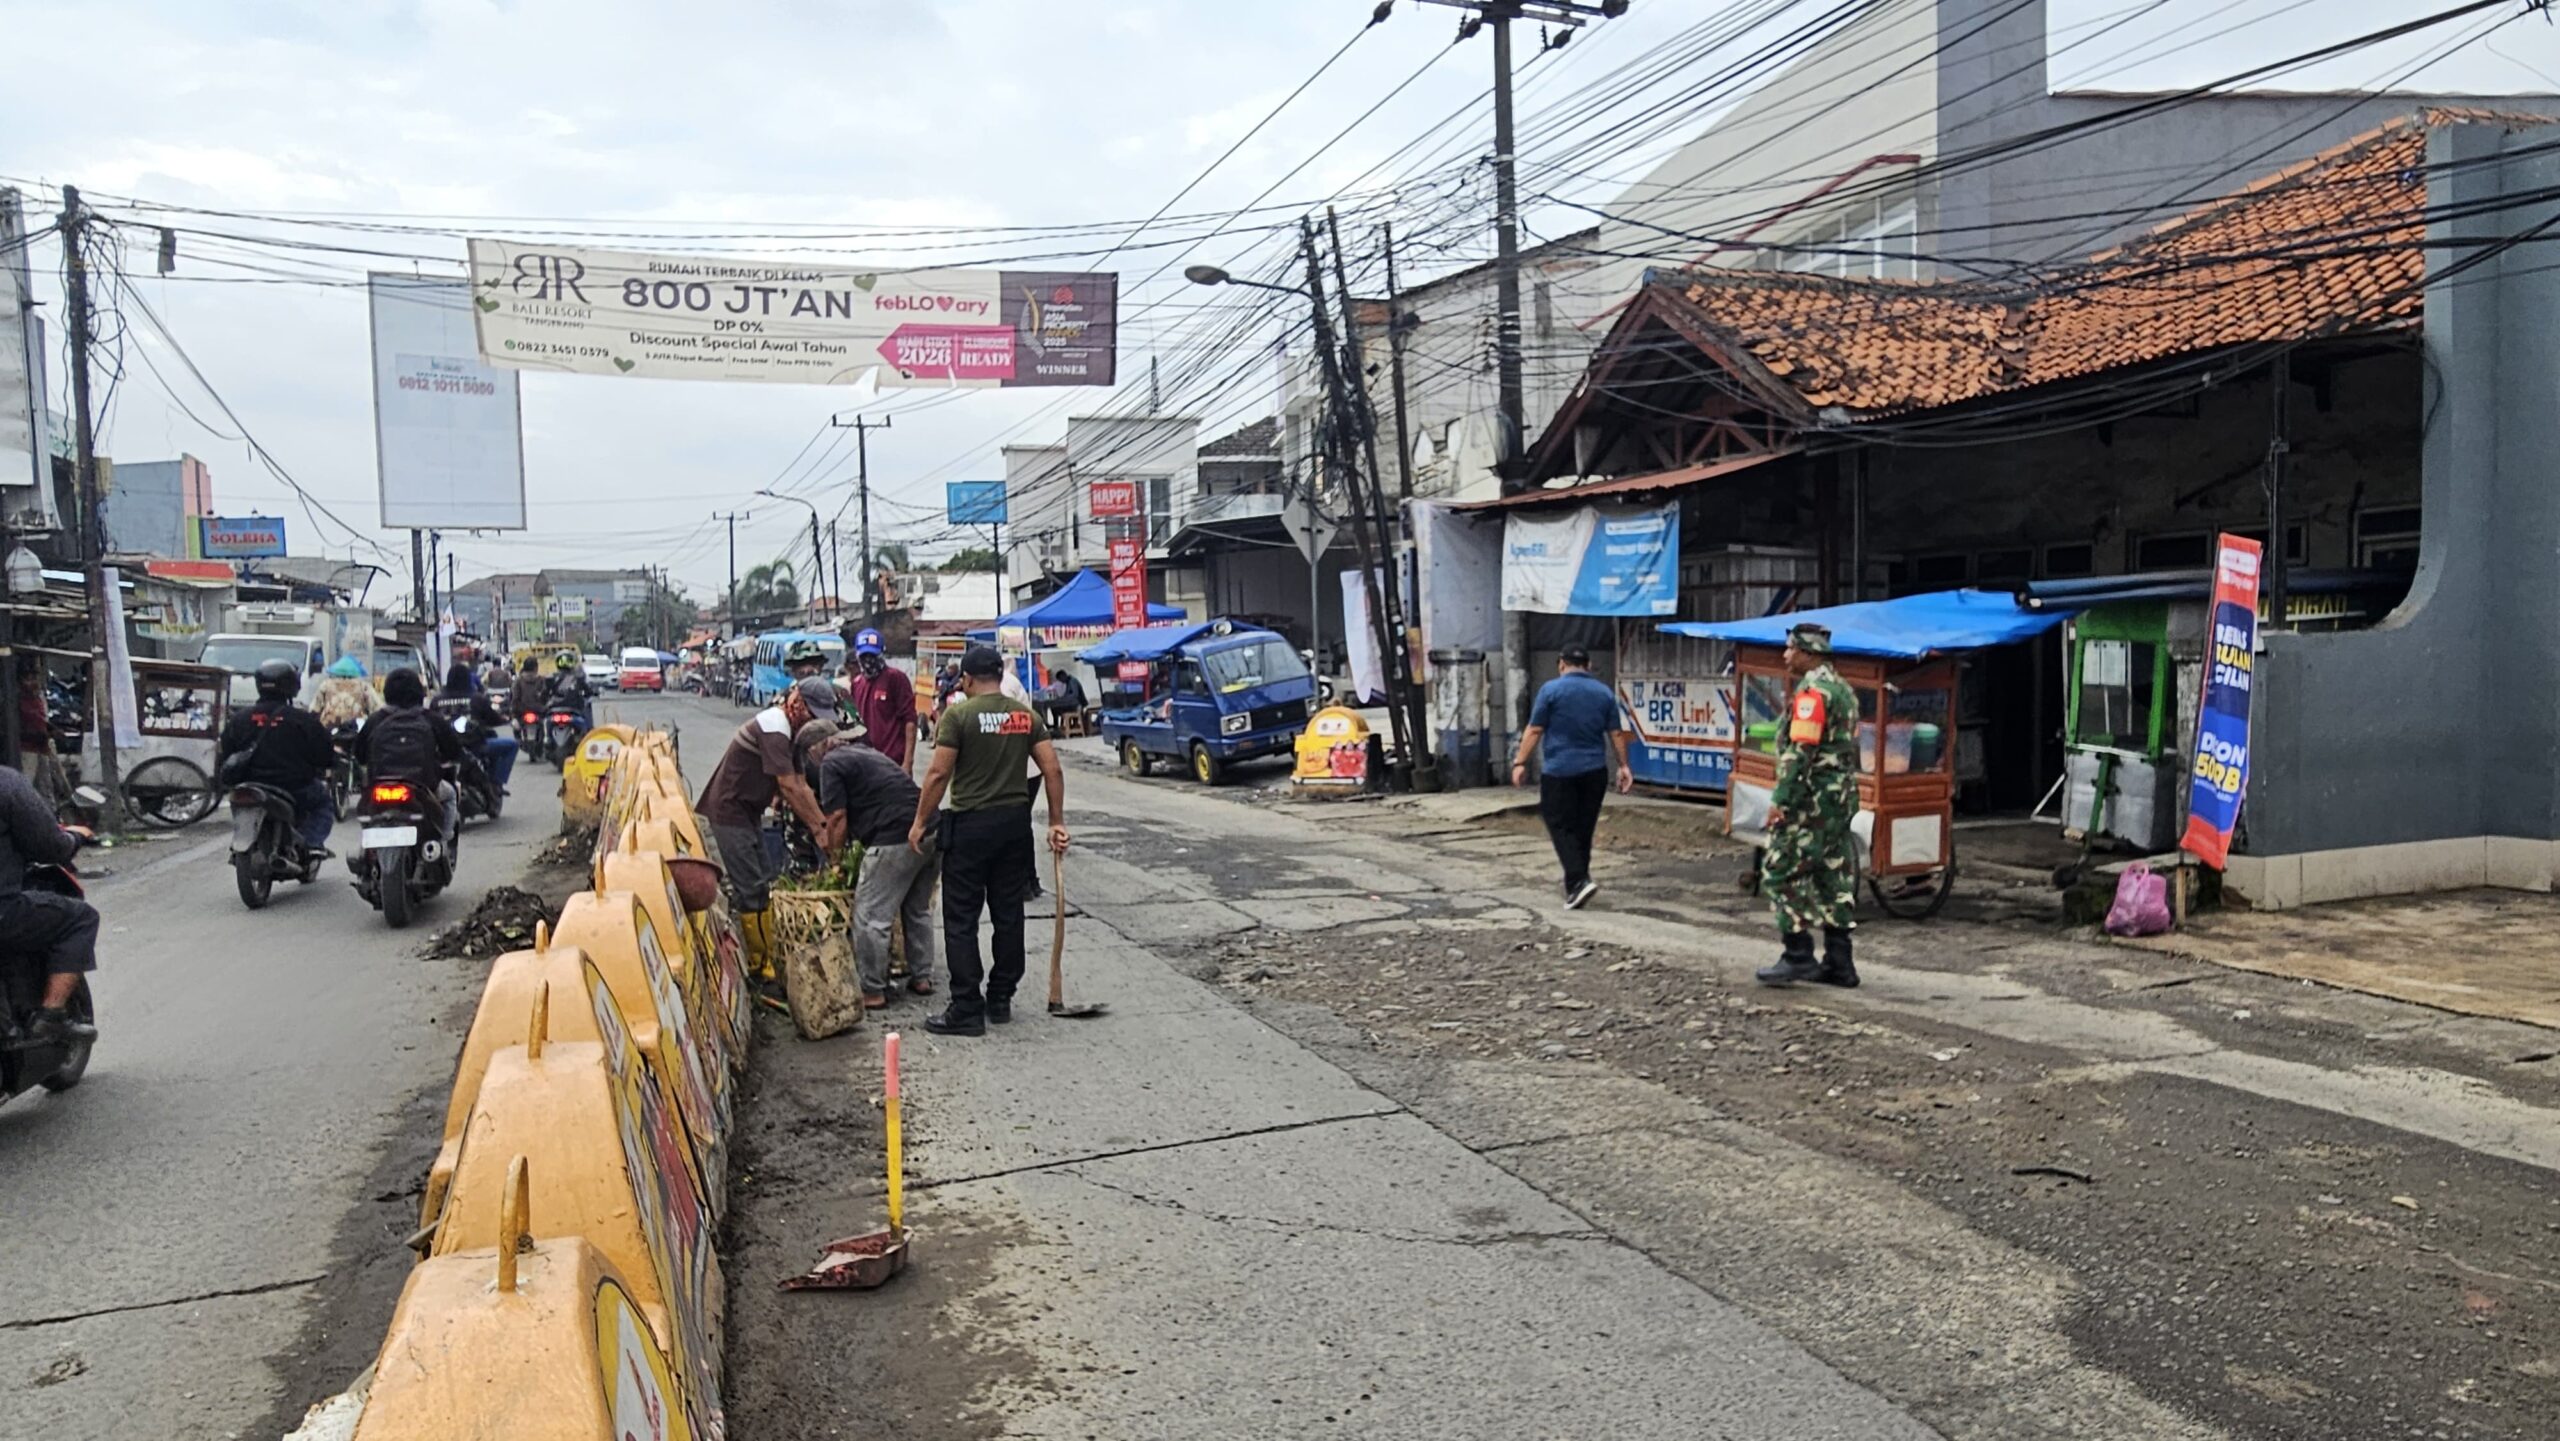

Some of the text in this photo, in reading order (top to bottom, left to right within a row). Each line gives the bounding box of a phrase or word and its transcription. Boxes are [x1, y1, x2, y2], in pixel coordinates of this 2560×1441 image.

[649, 262, 701, 276] RUMAH
[705, 266, 761, 279] TERBAIK
[622, 278, 712, 312] 800
[512, 303, 594, 320] BALI RESORT
[713, 319, 766, 333] DP 0%
[517, 341, 548, 353] 0822
[630, 332, 848, 356] Discount Special Awal Tahun
[897, 347, 952, 366] 2026
[960, 351, 1014, 367] READY
[1036, 364, 1088, 376] WINNER
[1092, 488, 1132, 505] HAPPY
